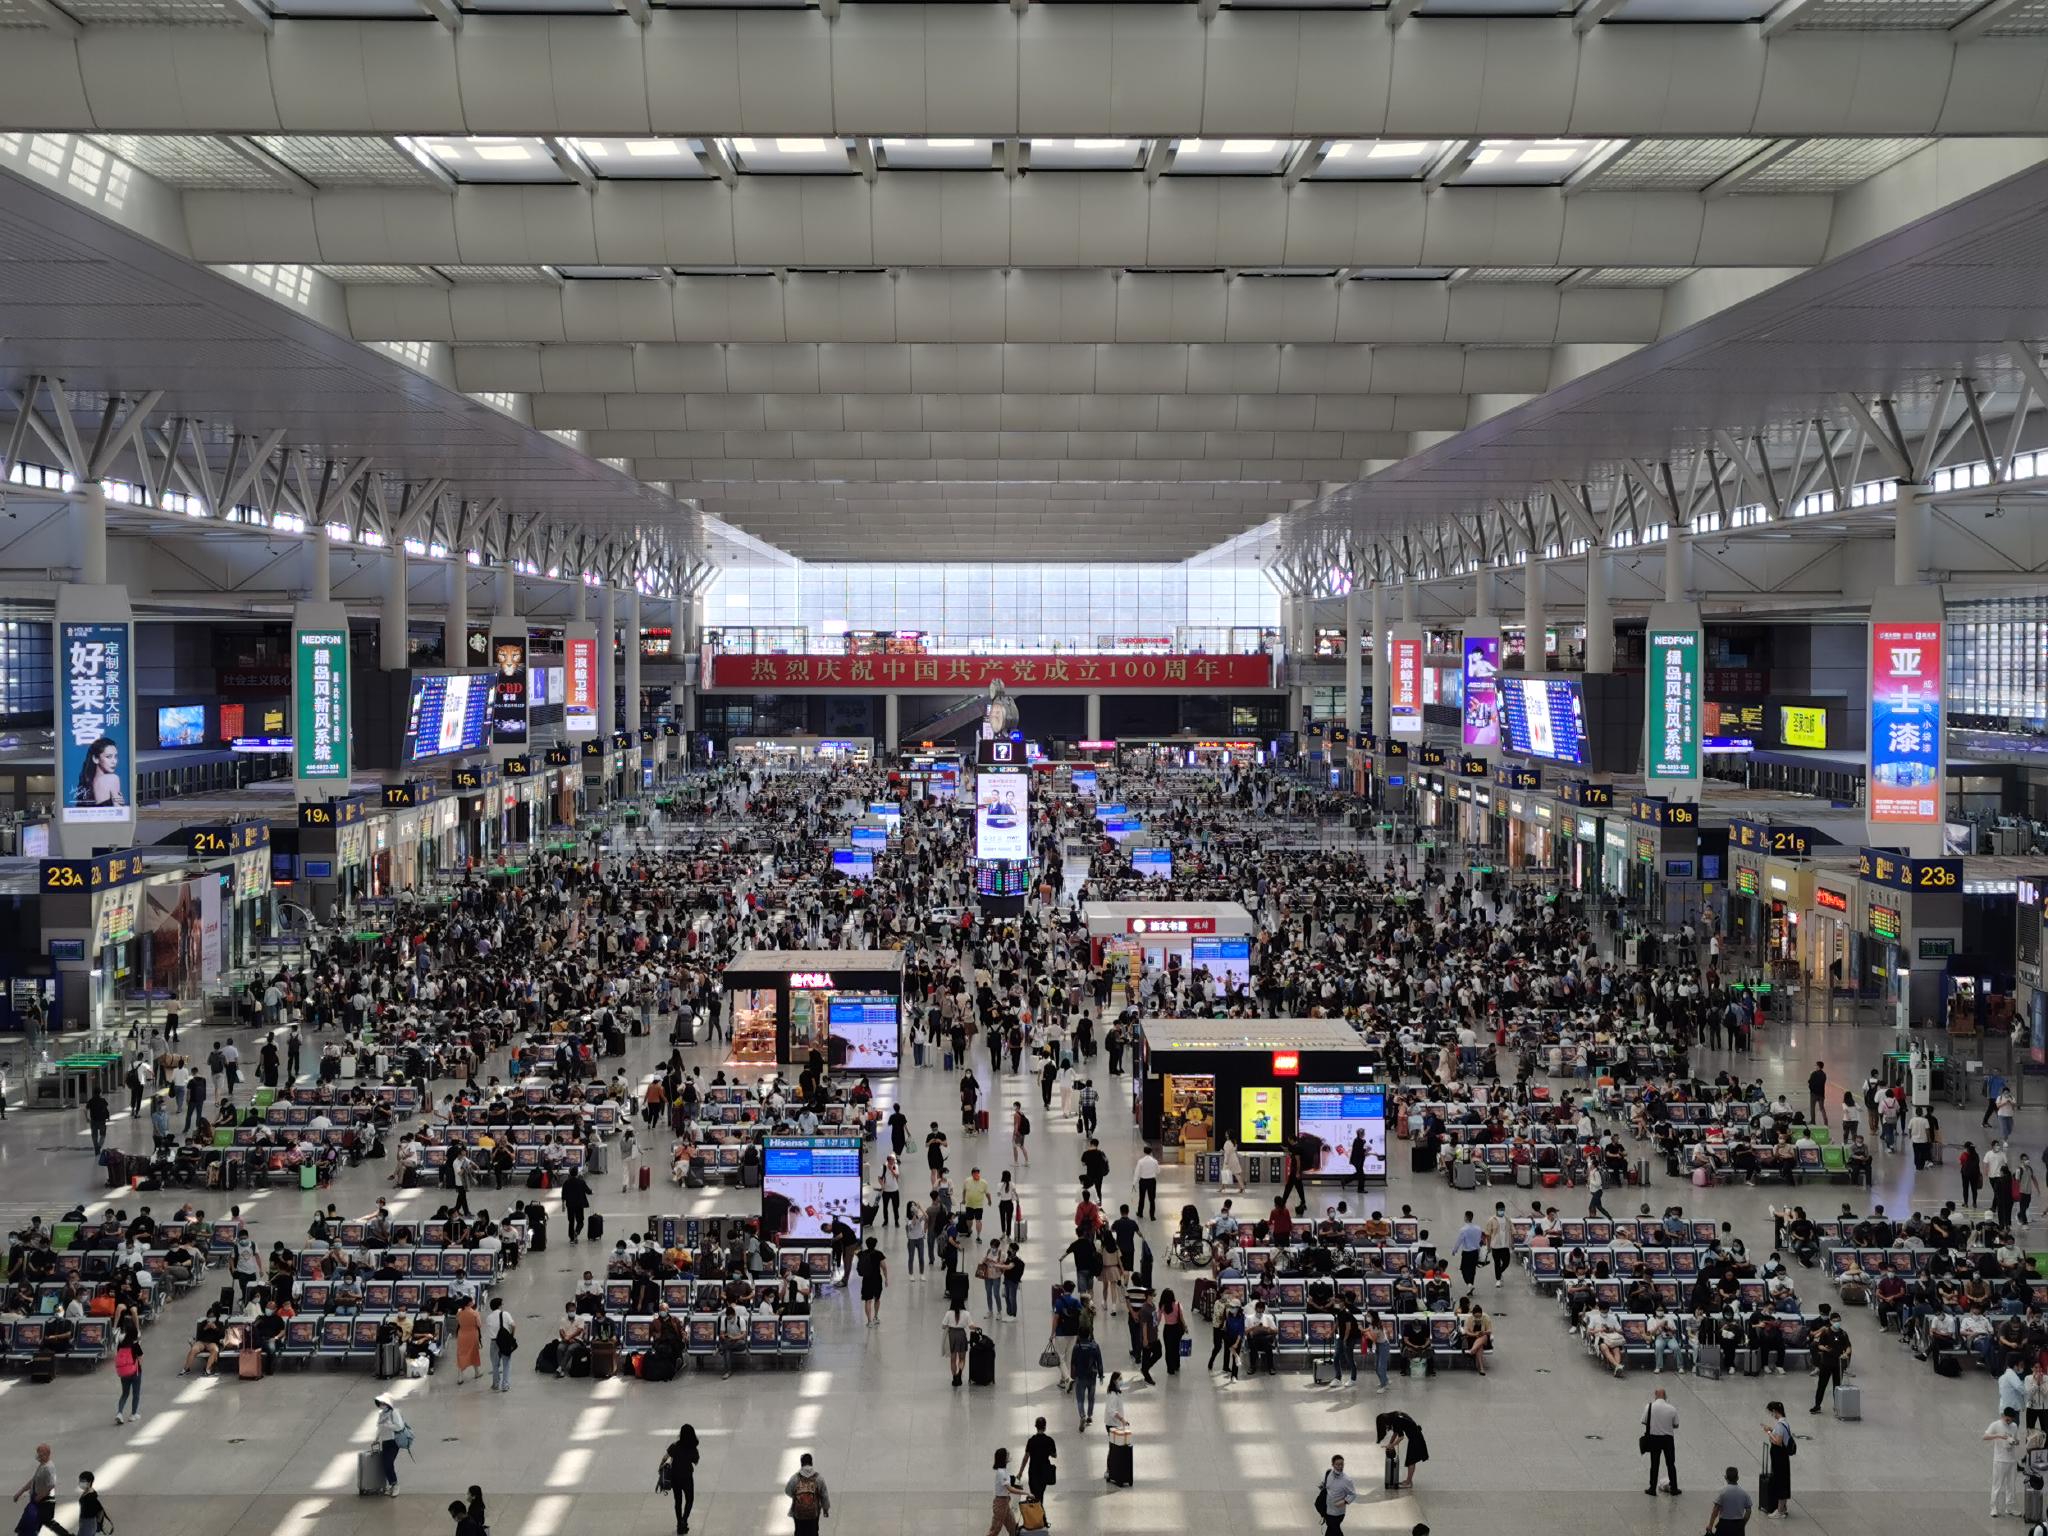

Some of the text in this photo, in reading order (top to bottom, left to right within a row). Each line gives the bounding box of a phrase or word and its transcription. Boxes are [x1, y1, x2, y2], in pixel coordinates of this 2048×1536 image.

[302, 635, 341, 644] NEDFON
[1654, 636, 1694, 645] NEDFON
[105, 642, 120, 727] 定制家居大师
[497, 682, 524, 693] CBD
[70, 641, 104, 746] 好莱客
[314, 649, 331, 761] 绿岛风新风系统
[1664, 650, 1682, 761] 绿岛风新风系统
[1889, 647, 1922, 753] 亚士漆
[616, 737, 627, 746] 7A
[1361, 737, 1372, 747] 7B
[587, 744, 598, 753] 9A
[1391, 744, 1402, 753] 9B
[551, 752, 567, 762] 11A
[1424, 752, 1440, 762] 11B
[508, 762, 526, 773] 13A
[1465, 761, 1483, 773] 13B
[457, 773, 476, 785] 15A
[1516, 773, 1537, 785] 15B
[387, 789, 410, 803] 17A
[1585, 789, 1608, 802] 17B
[304, 808, 330, 823] 19A
[1668, 808, 1693, 823] 19B
[194, 833, 225, 850] 21A
[1775, 832, 1805, 850] 21B
[47, 867, 83, 886] 23A
[1920, 866, 1956, 886] 23B
[1303, 1086, 1340, 1095] Hisense
[770, 1139, 810, 1148] Hisense
